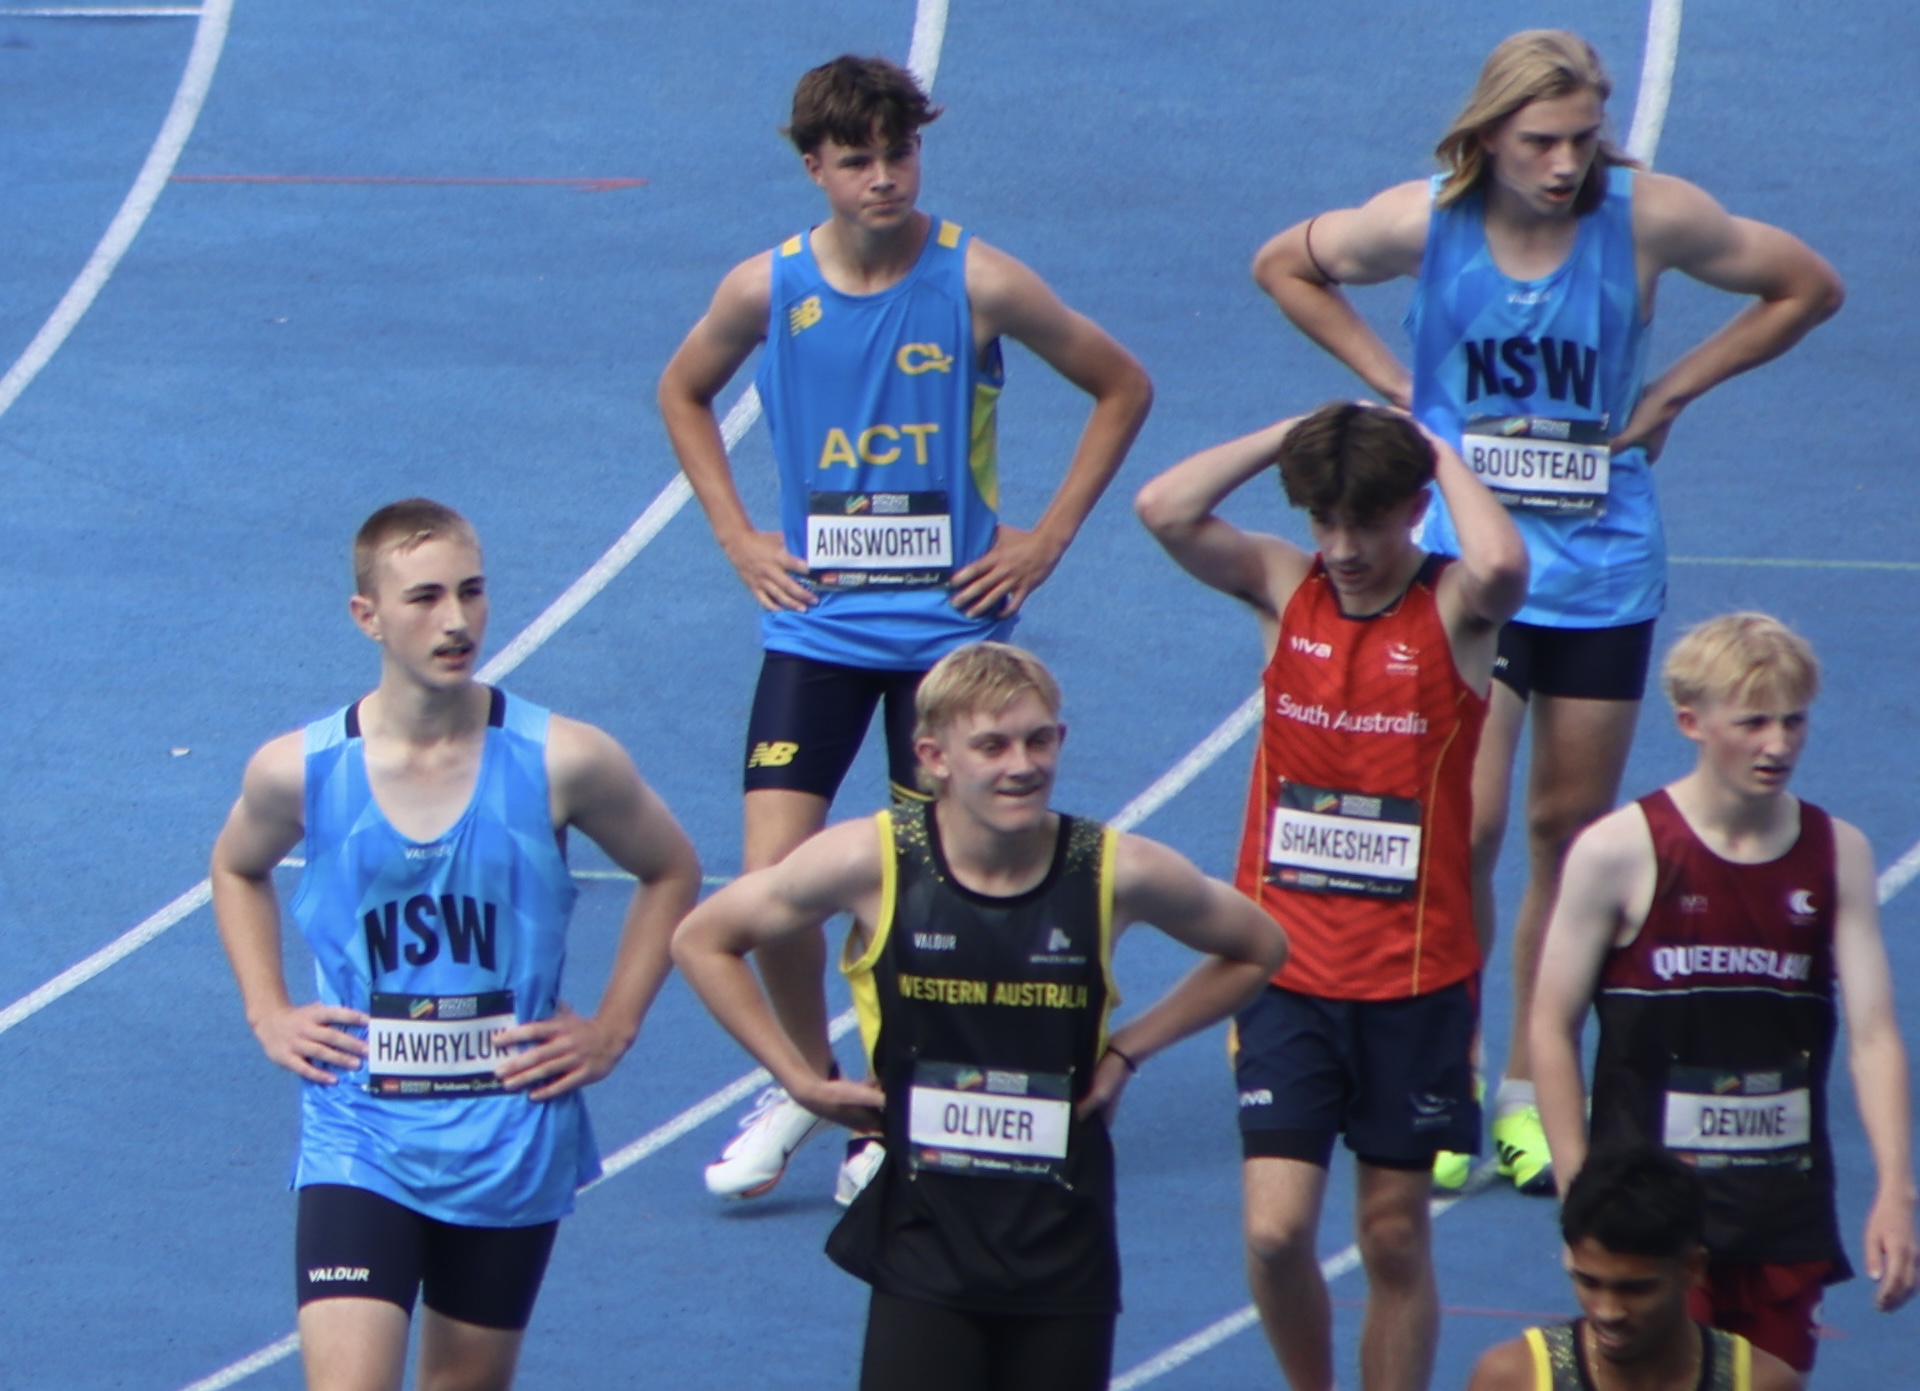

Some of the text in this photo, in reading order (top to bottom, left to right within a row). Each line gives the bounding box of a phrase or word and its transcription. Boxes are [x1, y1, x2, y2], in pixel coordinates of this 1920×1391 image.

[1464, 335, 1598, 411] NSW
[818, 423, 940, 469] ACT
[1472, 447, 1597, 481] BOUSTEAD
[815, 526, 942, 556] AINSWORTH
[1276, 693, 1429, 735] South Australia
[1280, 821, 1411, 867] SHAKESHAFT
[364, 893, 498, 983] NSW
[914, 933, 958, 950] VALOUR
[899, 973, 988, 1005] WESTERN
[943, 1103, 1034, 1141] OLIVER
[1700, 1106, 1786, 1138] DEVINE
[308, 1267, 371, 1283] VALOUR
